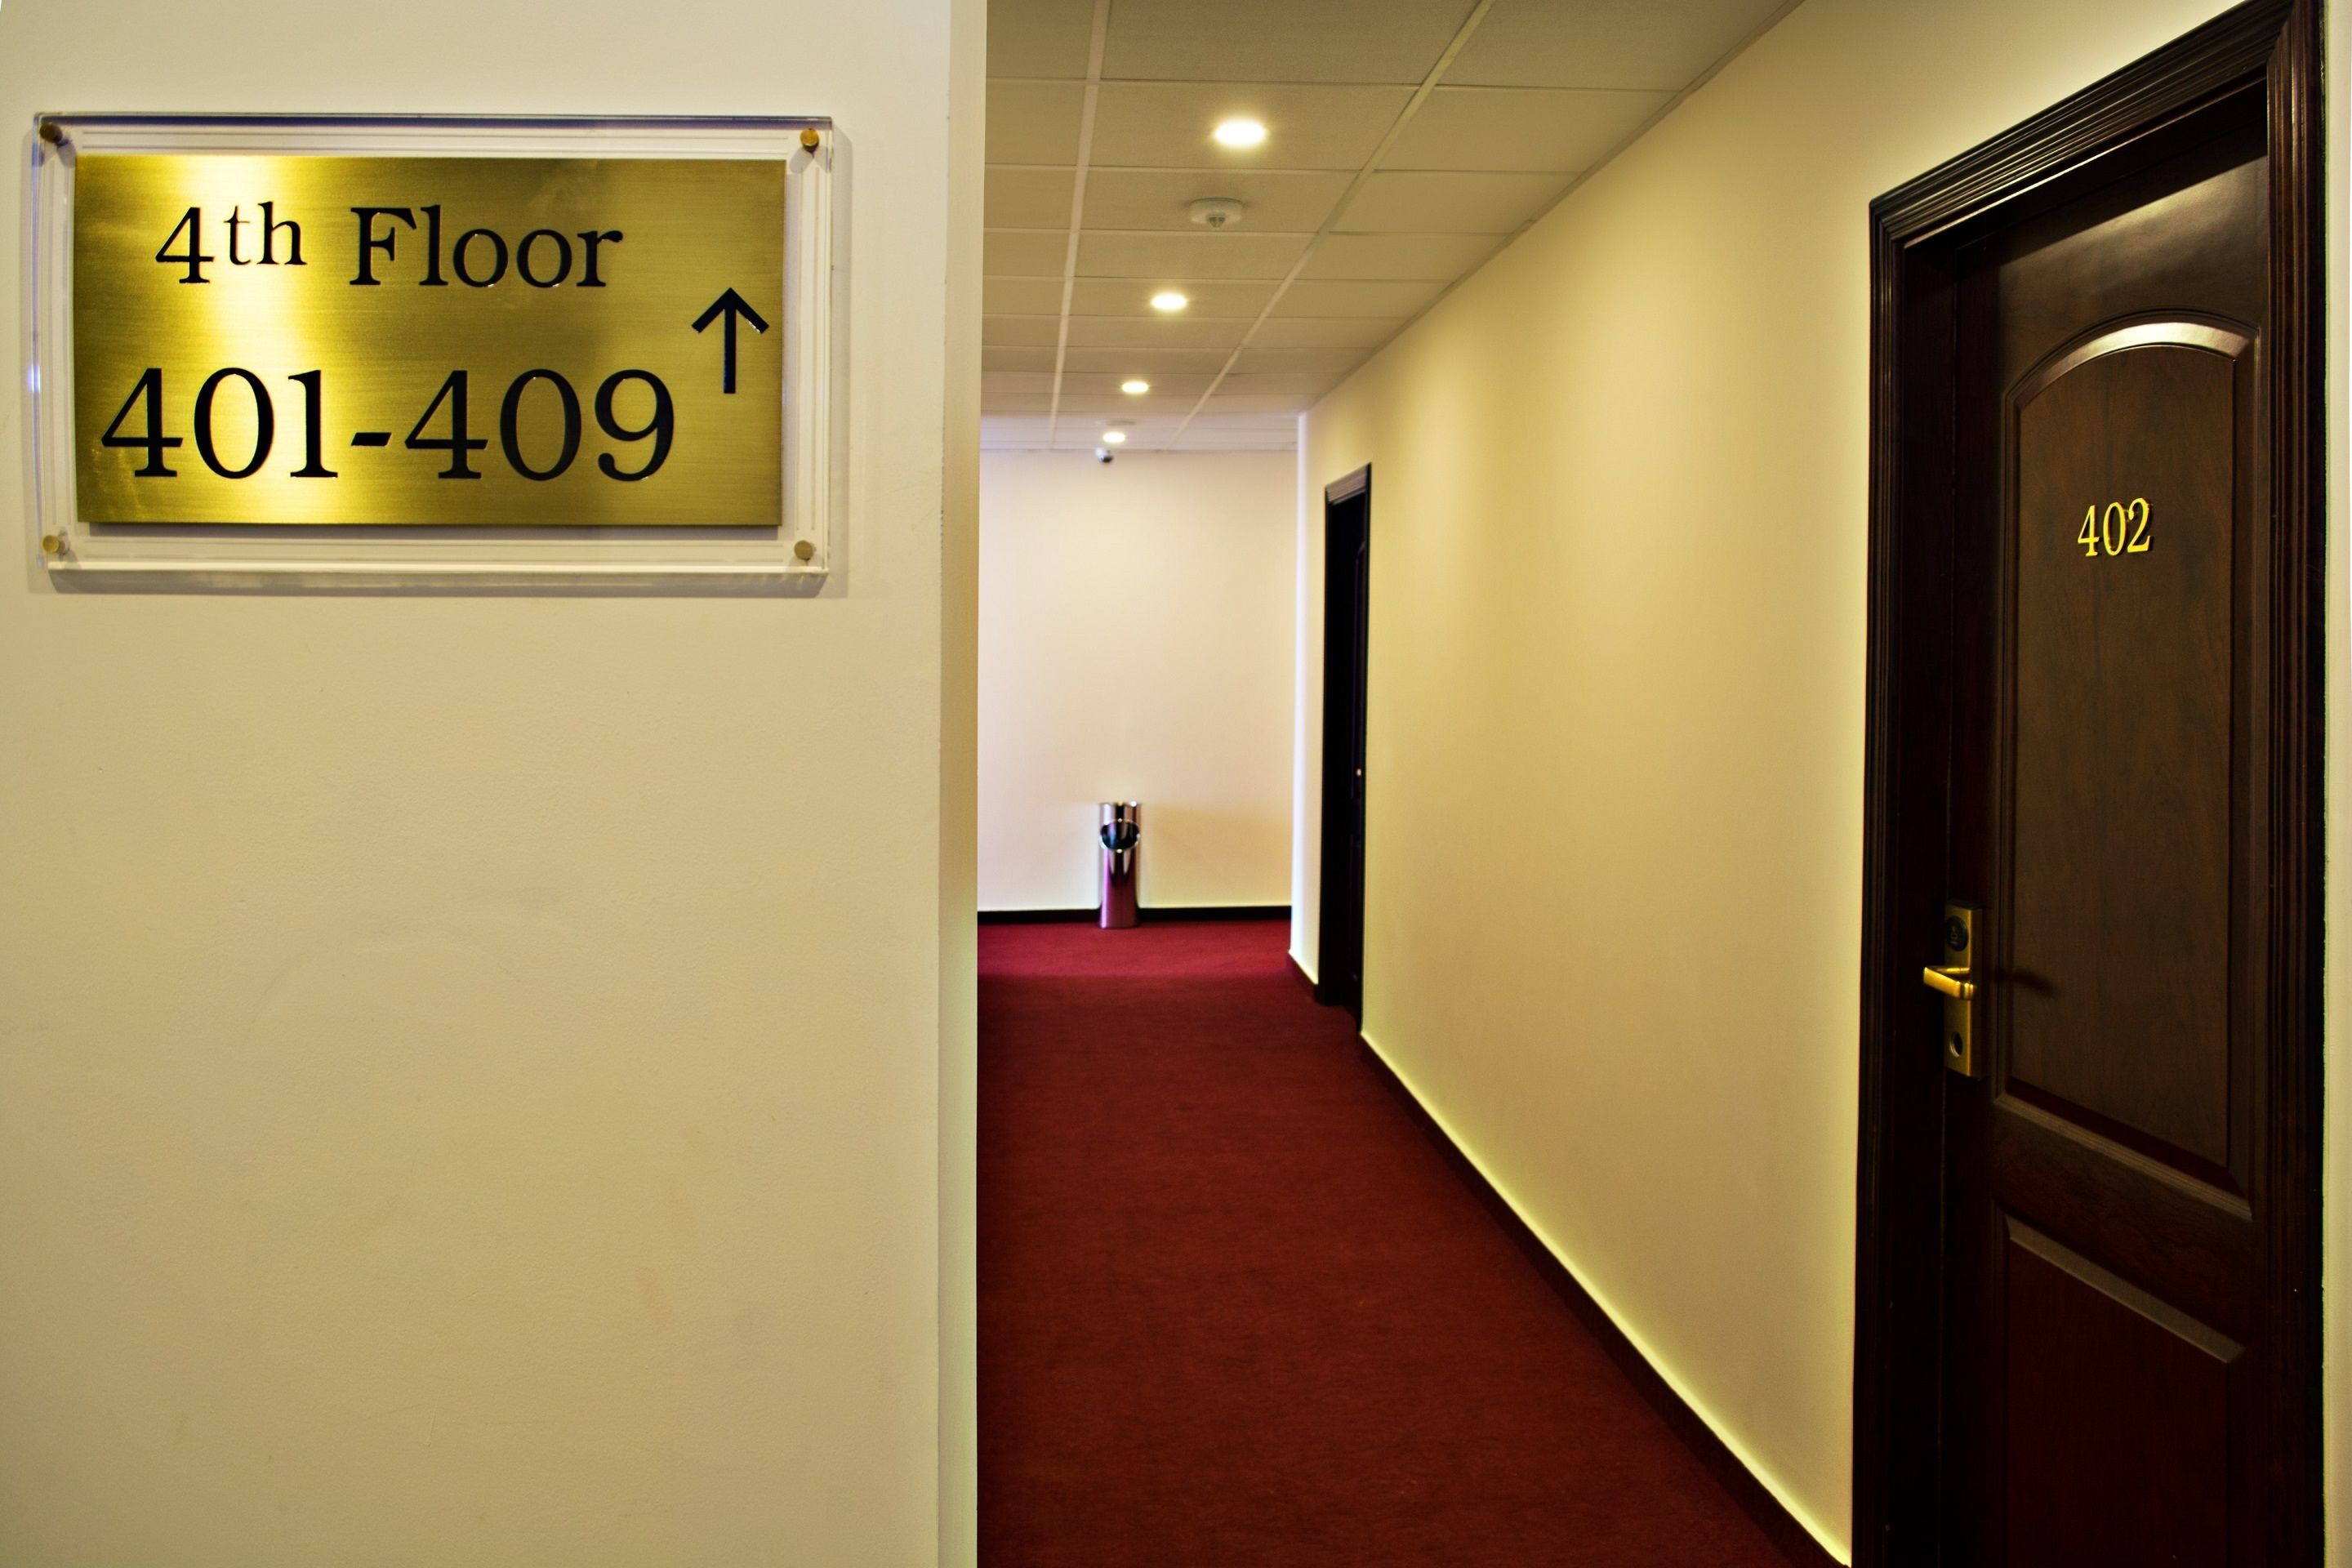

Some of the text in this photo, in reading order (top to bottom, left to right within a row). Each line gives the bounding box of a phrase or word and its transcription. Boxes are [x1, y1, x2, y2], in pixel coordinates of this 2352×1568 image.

[155, 202, 623, 288] 4th Floor
[100, 368, 675, 482] 401-409
[2077, 497, 2152, 557] 402
